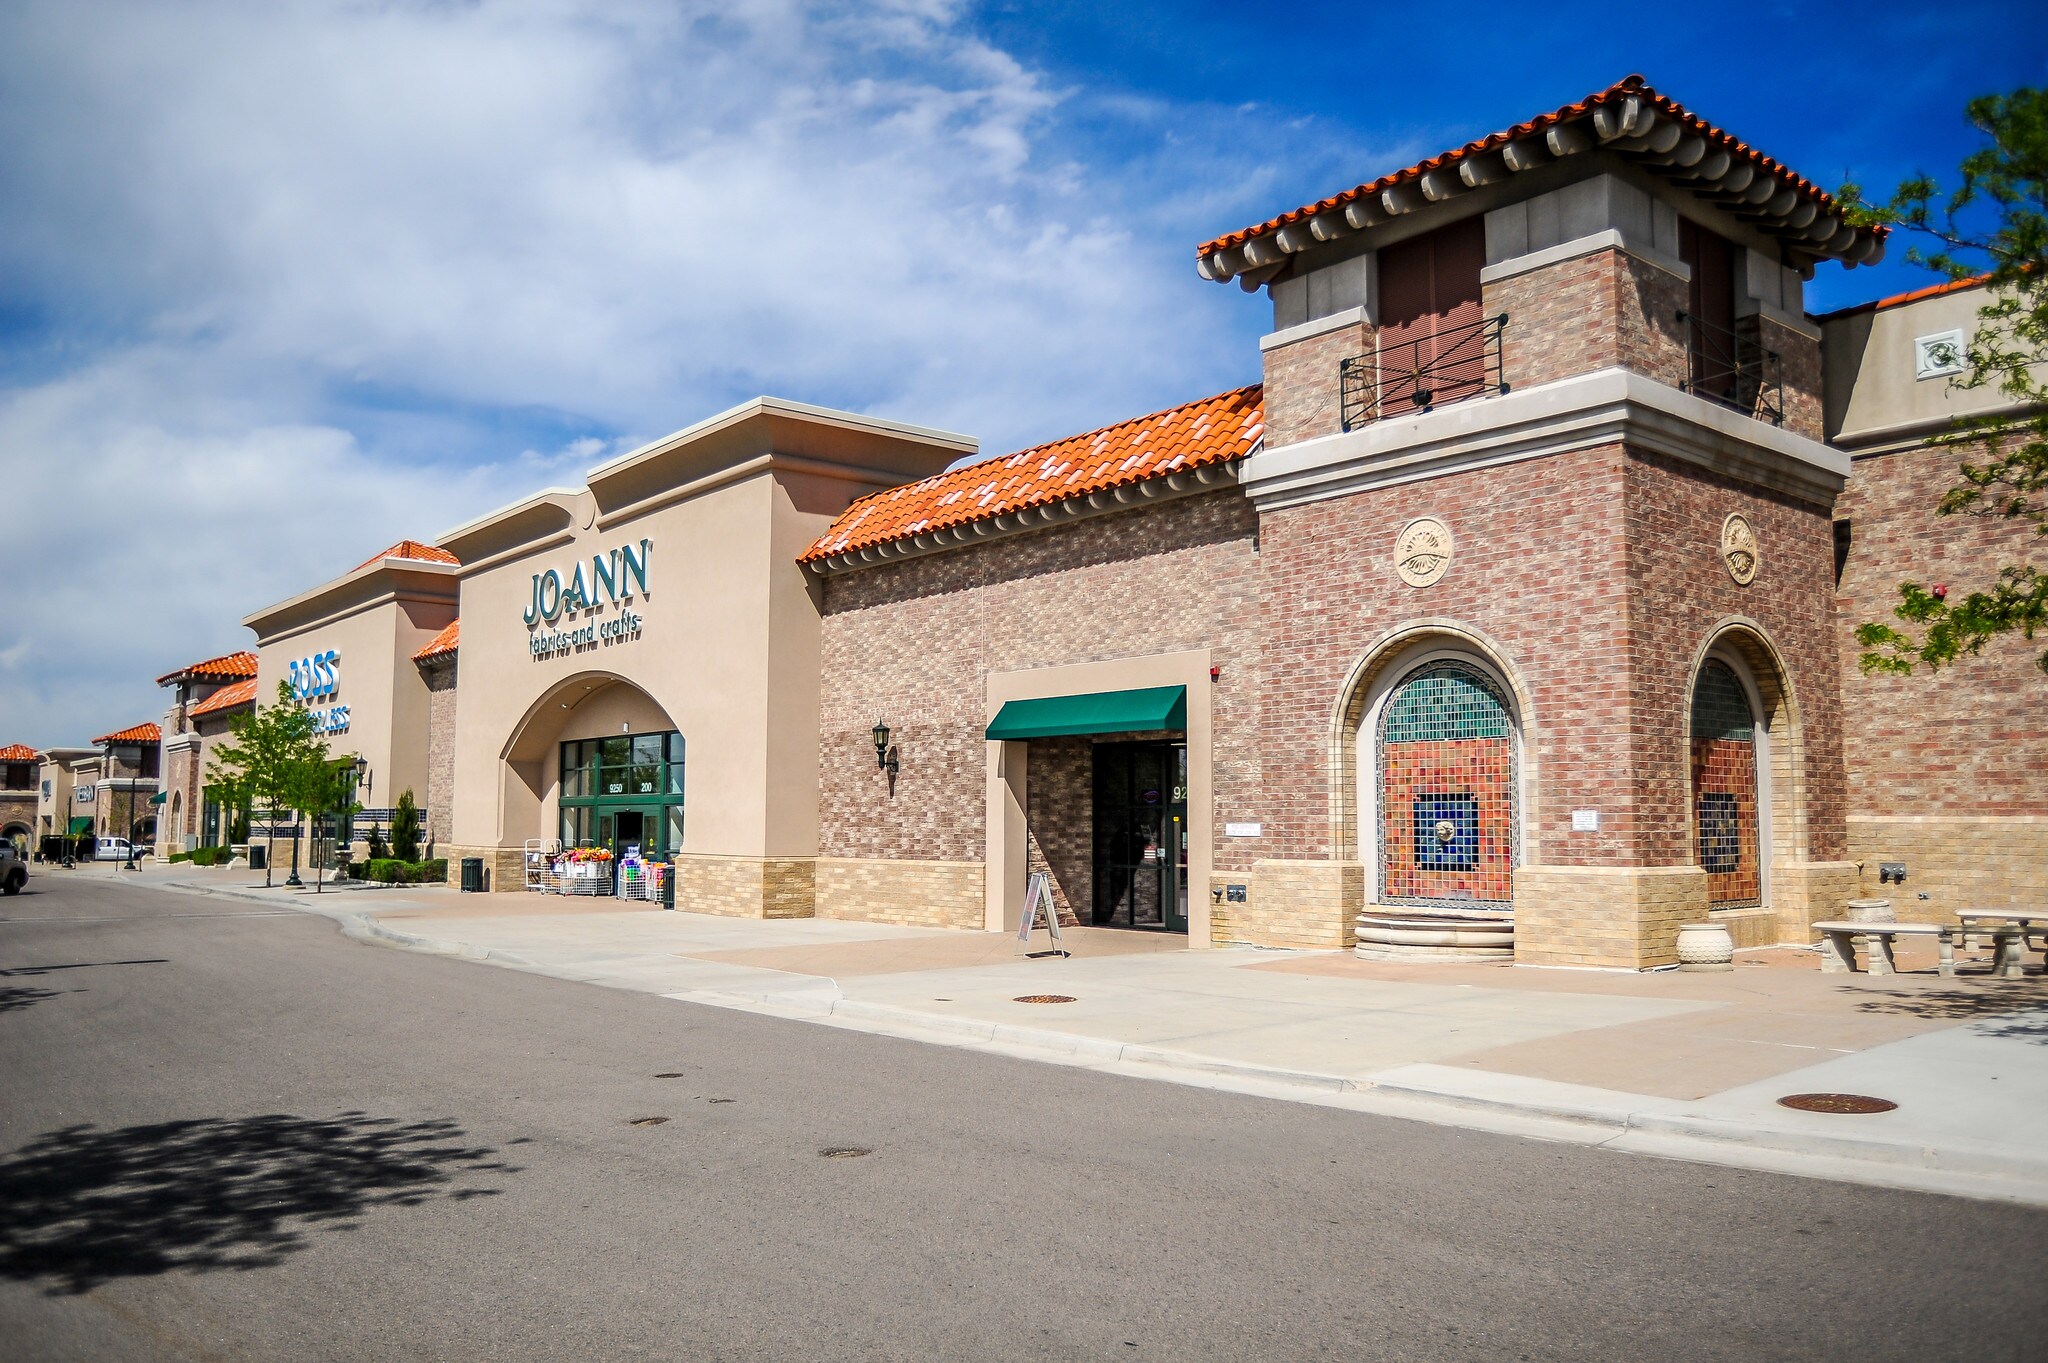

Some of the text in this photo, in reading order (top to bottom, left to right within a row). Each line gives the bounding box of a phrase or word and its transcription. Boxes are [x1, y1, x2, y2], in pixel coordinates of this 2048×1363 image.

[529, 608, 642, 655] fabrics and crafts
[641, 782, 652, 792] 200
